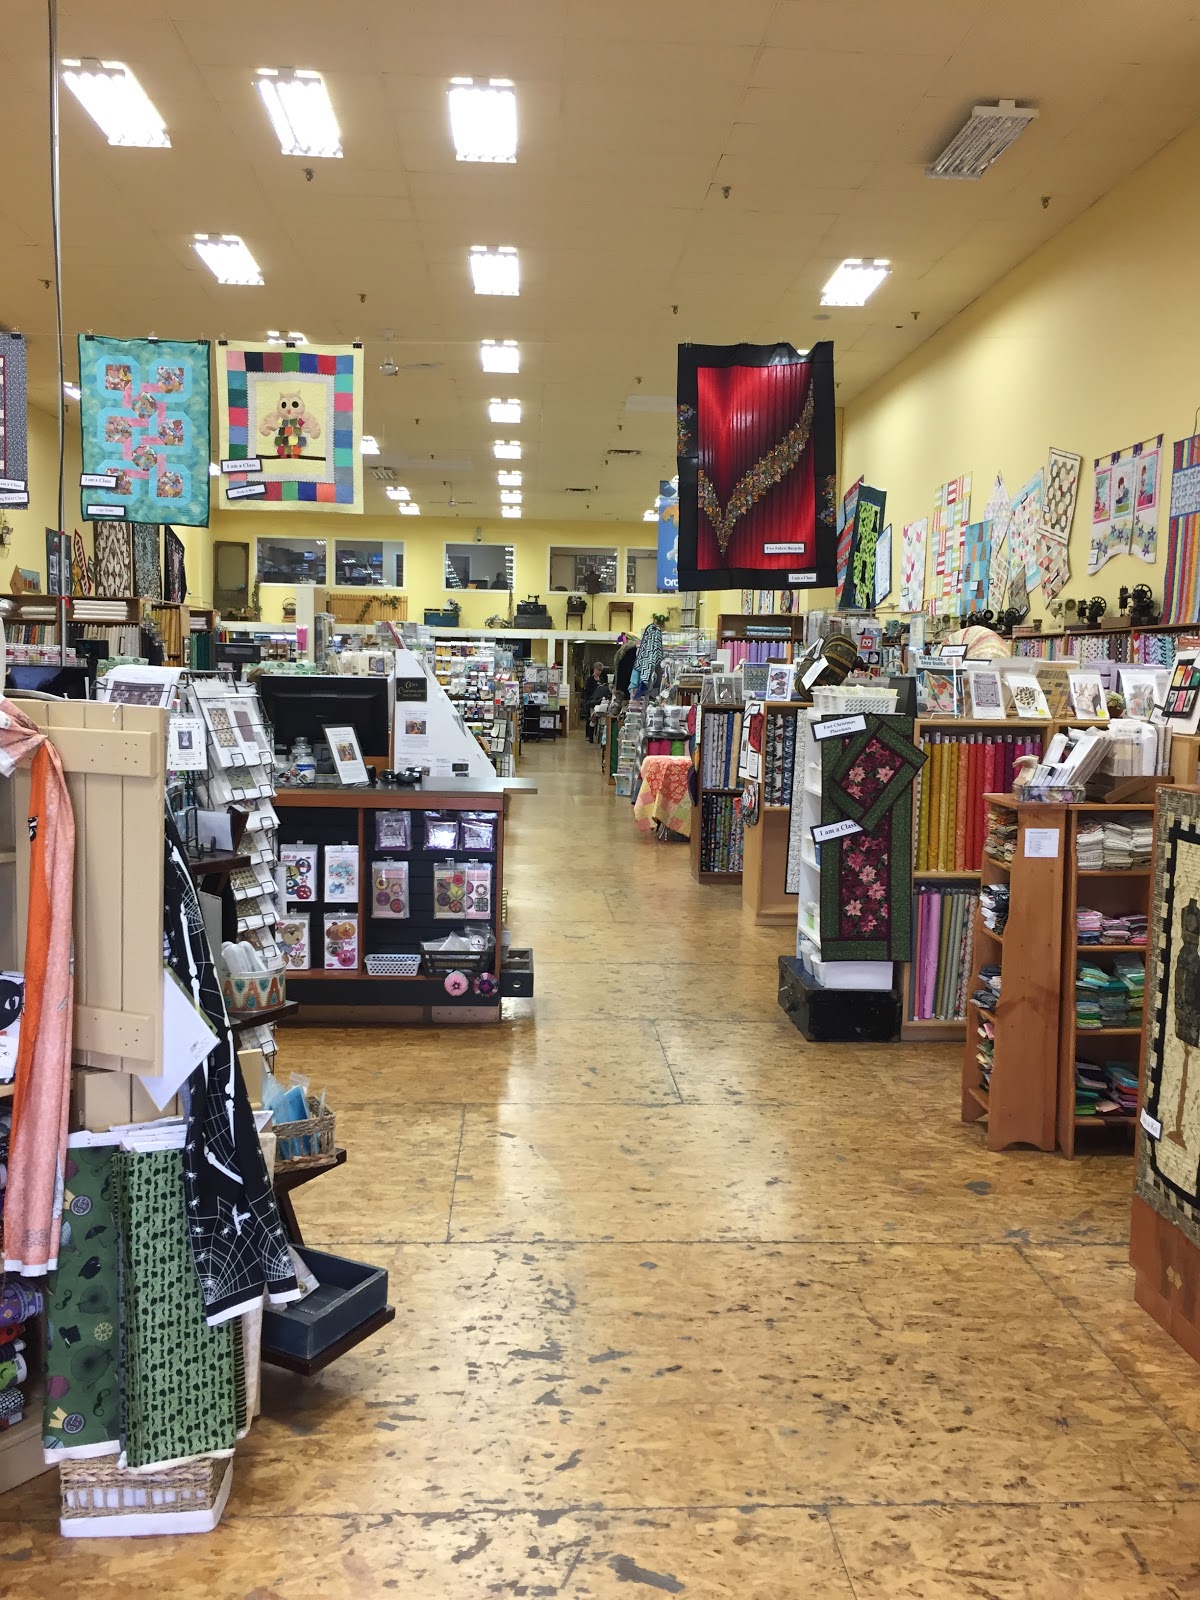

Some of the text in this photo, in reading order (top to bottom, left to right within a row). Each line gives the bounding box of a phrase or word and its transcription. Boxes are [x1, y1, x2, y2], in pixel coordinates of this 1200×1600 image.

[833, 719, 856, 728] Christmas
[830, 726, 852, 734] Placemats
[840, 822, 857, 831] Class
